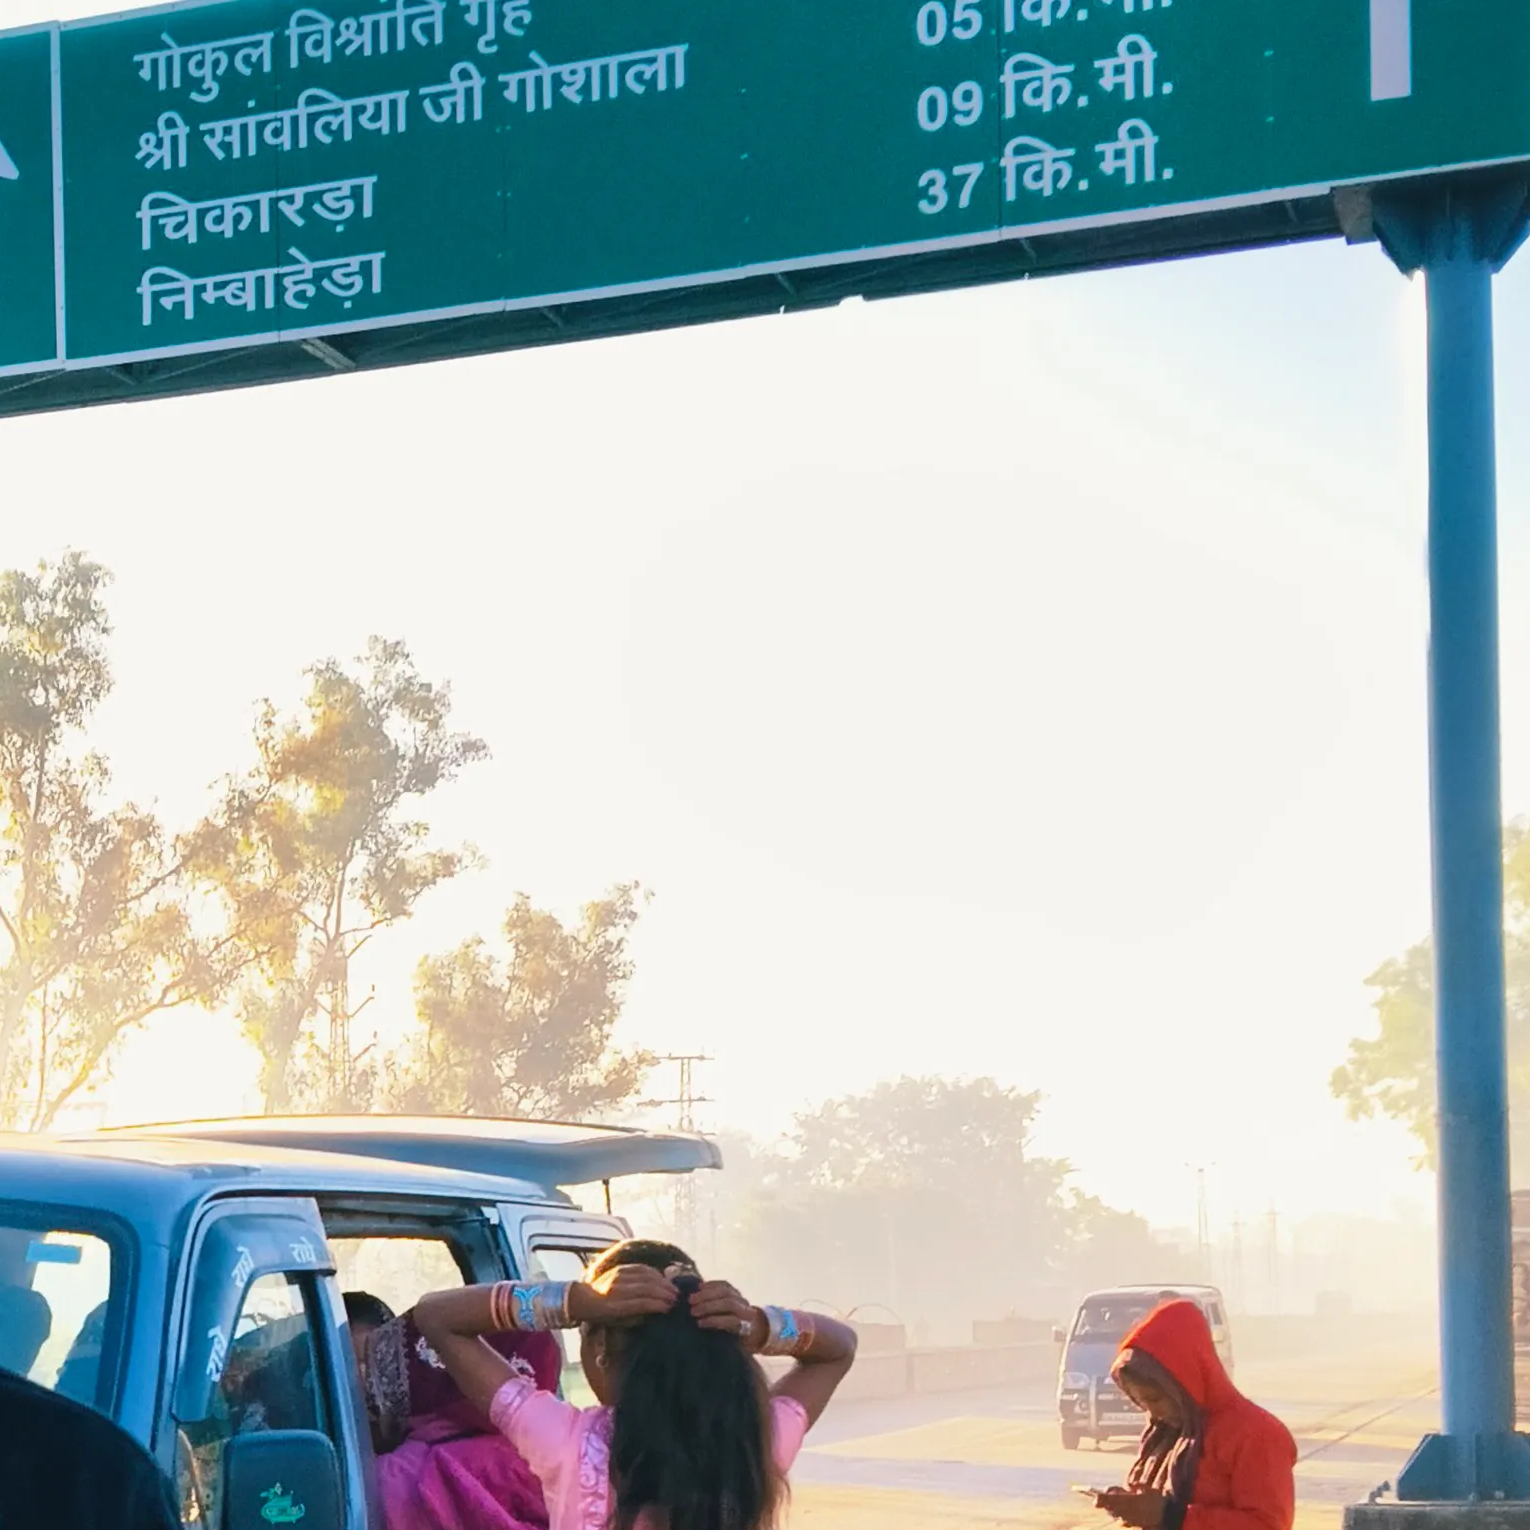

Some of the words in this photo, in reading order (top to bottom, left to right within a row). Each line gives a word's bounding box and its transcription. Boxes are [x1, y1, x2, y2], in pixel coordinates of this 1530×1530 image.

[133, 32, 274, 103] गोकुल
[285, 0, 446, 68] विश्राति
[134, 111, 188, 171] श्री
[201, 87, 407, 160] सांवलिया
[419, 61, 486, 124] जी
[497, 42, 690, 113] गोशाला
[916, 0, 983, 46] 05
[135, 175, 377, 251] चिकारड़ा
[916, 80, 983, 132] 09
[136, 247, 386, 326] निम्बाहेड़ा
[917, 162, 984, 215] 37
